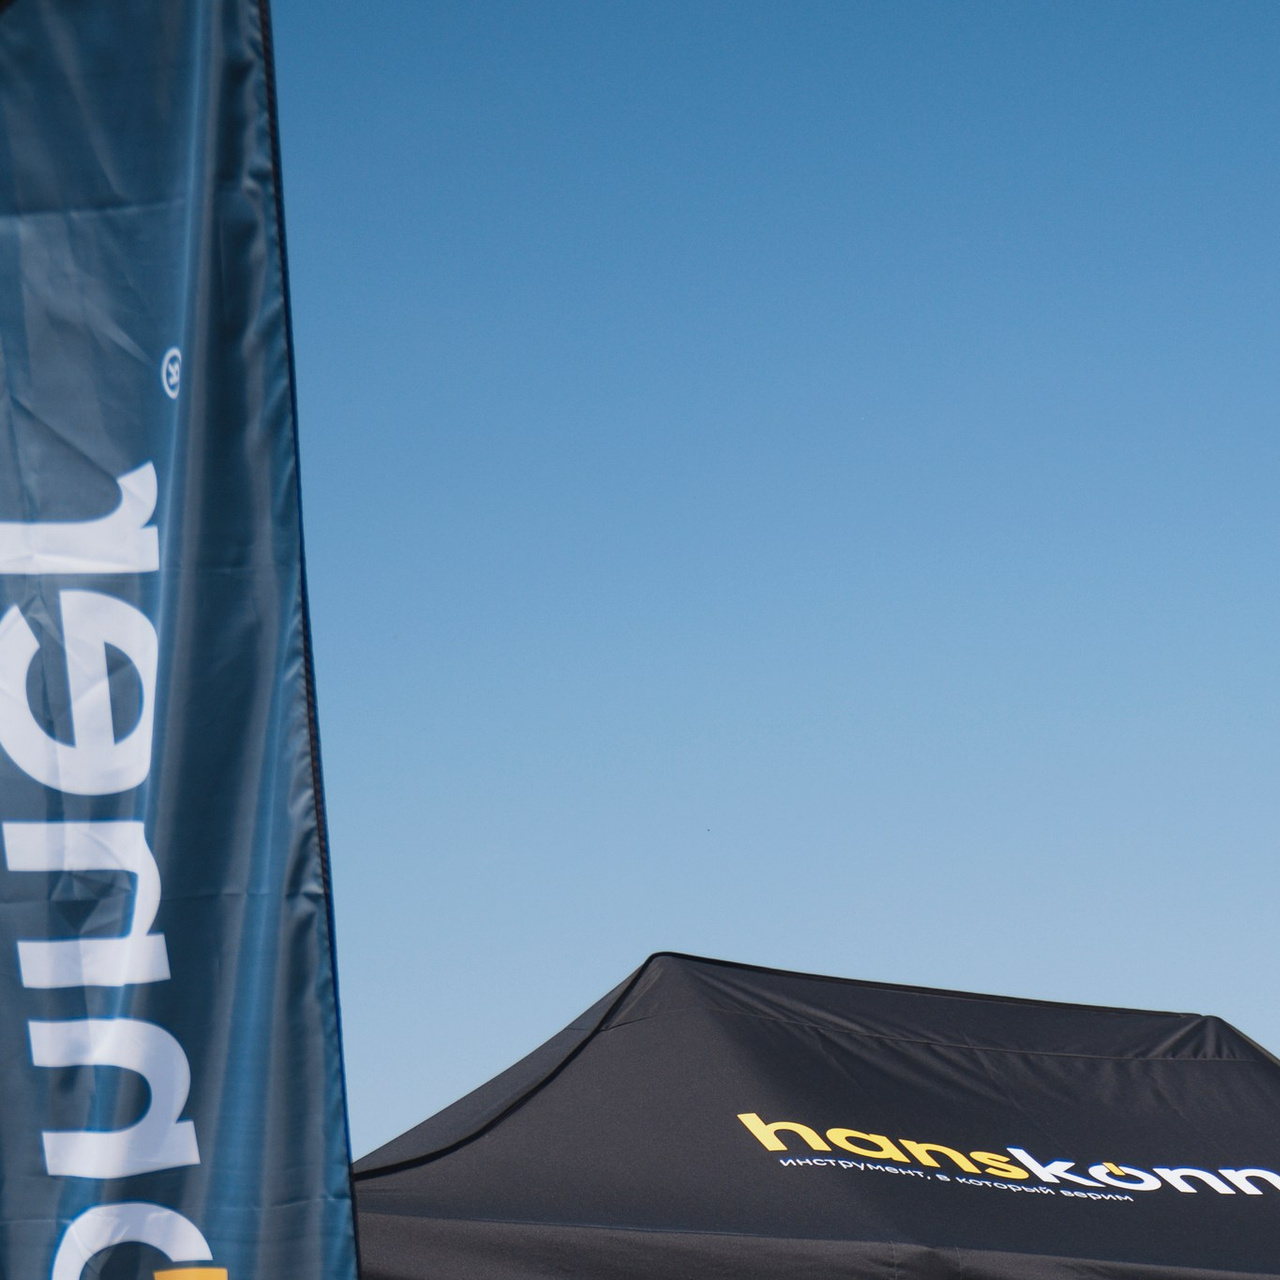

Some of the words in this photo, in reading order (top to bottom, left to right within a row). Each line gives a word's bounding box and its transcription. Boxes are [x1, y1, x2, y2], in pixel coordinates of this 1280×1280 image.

[780, 1158, 931, 1180] инструмент,
[936, 1173, 952, 1182] в
[956, 1177, 1056, 1196] который
[1059, 1190, 1135, 1202] верим
